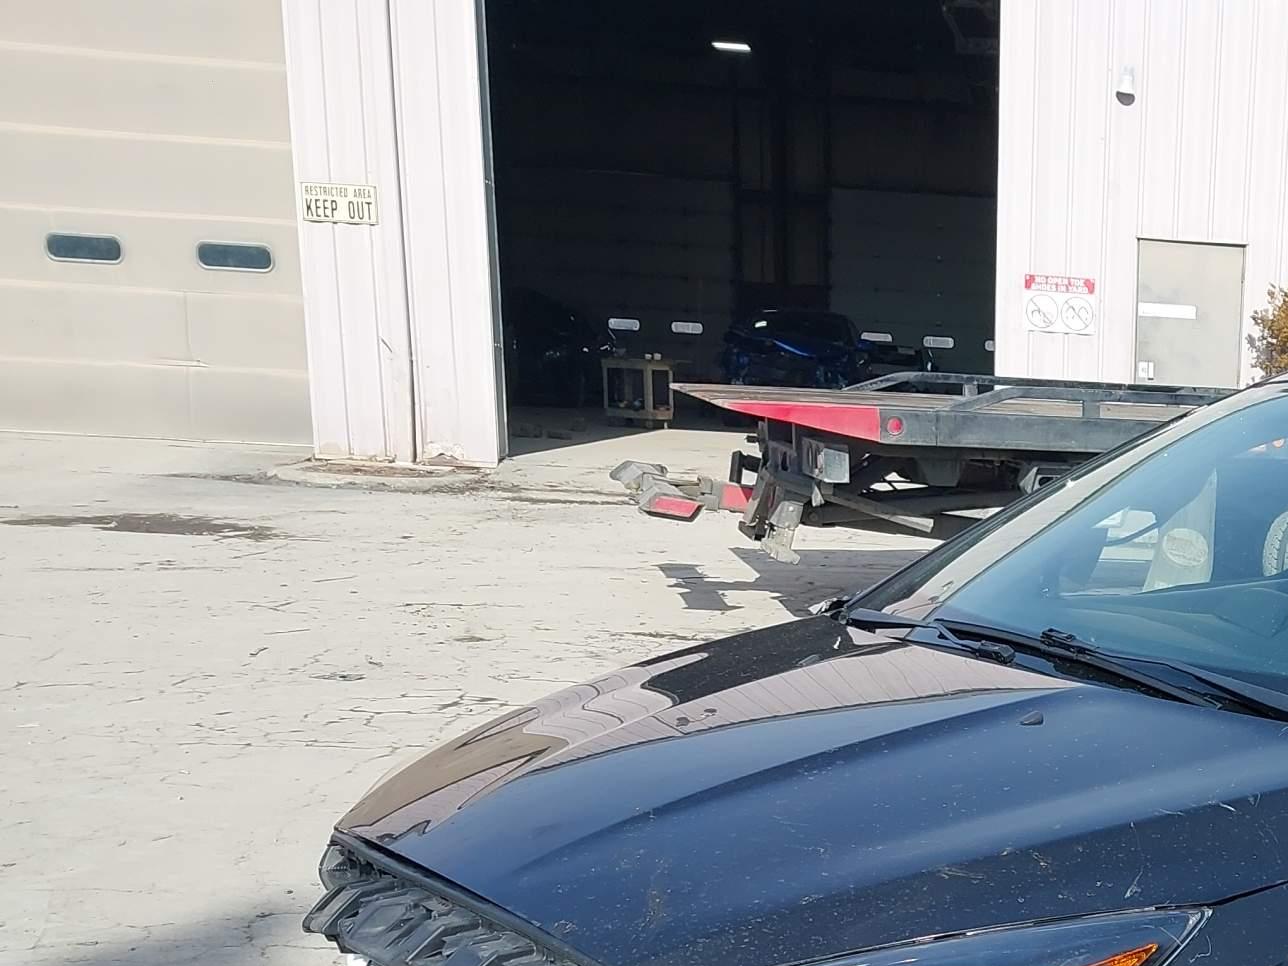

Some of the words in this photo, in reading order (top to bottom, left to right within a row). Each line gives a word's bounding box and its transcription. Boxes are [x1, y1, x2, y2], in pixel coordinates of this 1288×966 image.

[304, 185, 348, 198] RESTRICTED
[353, 188, 372, 199] AREA
[305, 198, 338, 218] KEEP
[347, 200, 373, 221] OUT
